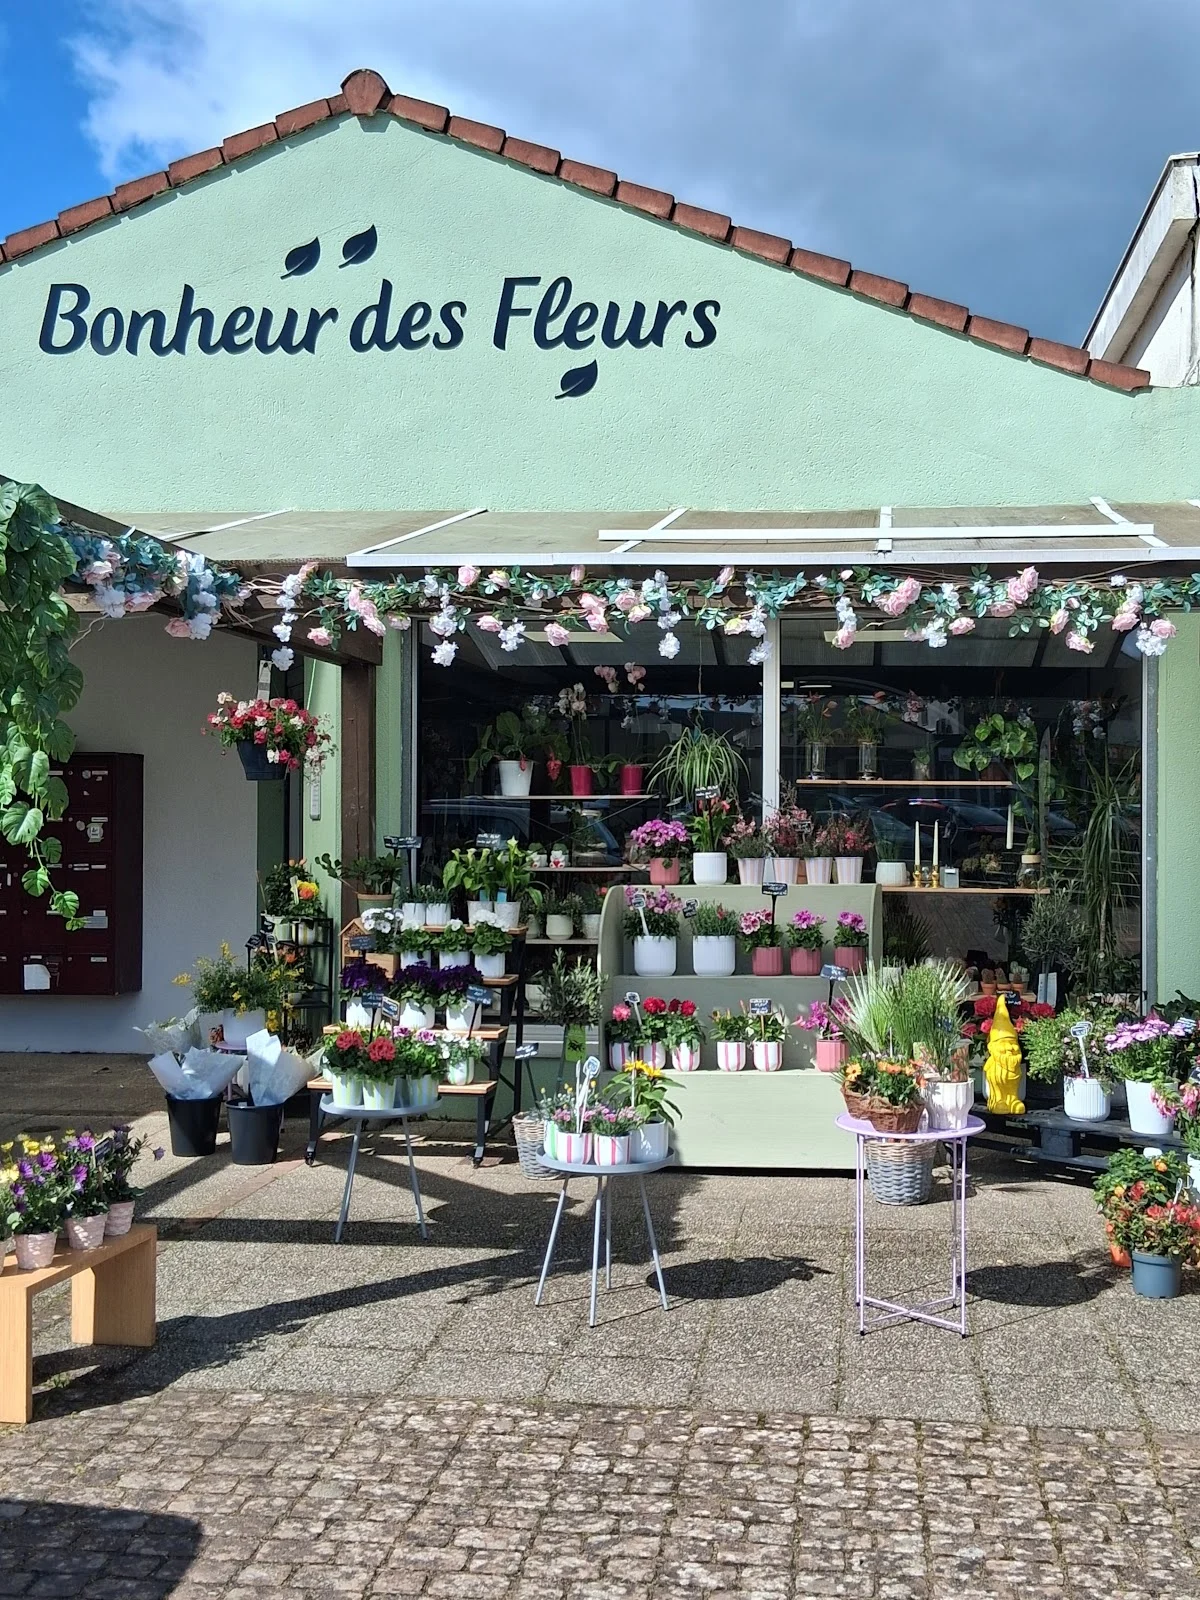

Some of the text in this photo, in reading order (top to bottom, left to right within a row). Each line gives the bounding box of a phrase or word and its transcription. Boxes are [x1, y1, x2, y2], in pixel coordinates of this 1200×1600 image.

[39, 277, 721, 355] Bonheur des Fleurs
